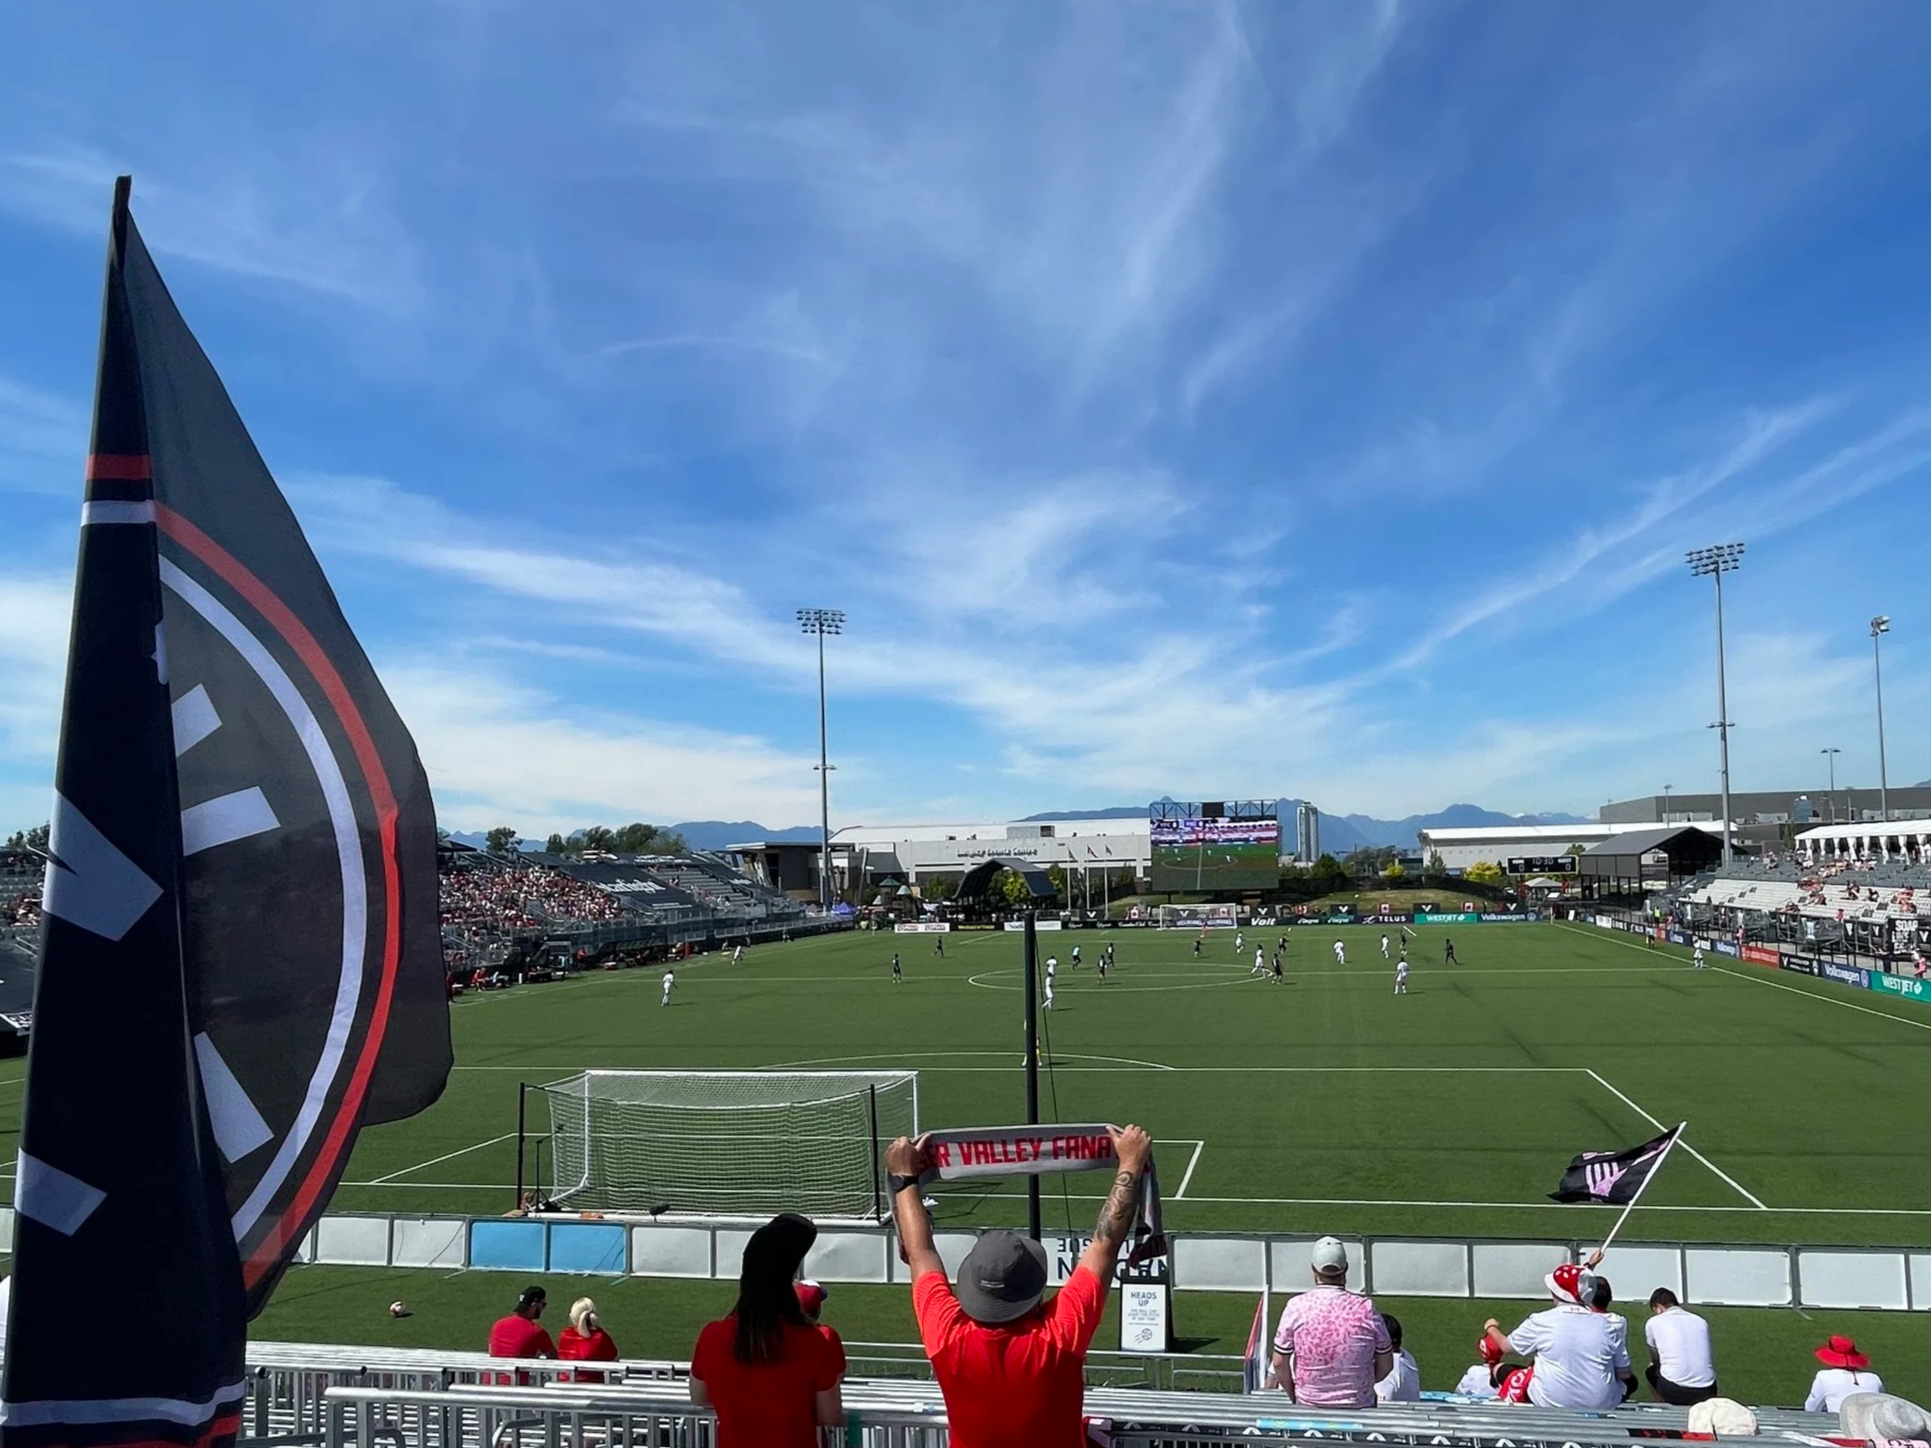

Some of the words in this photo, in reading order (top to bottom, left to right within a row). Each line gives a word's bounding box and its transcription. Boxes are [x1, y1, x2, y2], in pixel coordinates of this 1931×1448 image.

[1481, 913, 1525, 921] Volkswagen
[1824, 964, 1860, 983] Volkswagen
[957, 1137, 1044, 1166] VALLEY
[1051, 1135, 1111, 1160] FANA
[1130, 1291, 1157, 1300] HEADS
[1138, 1299, 1149, 1307] UP
